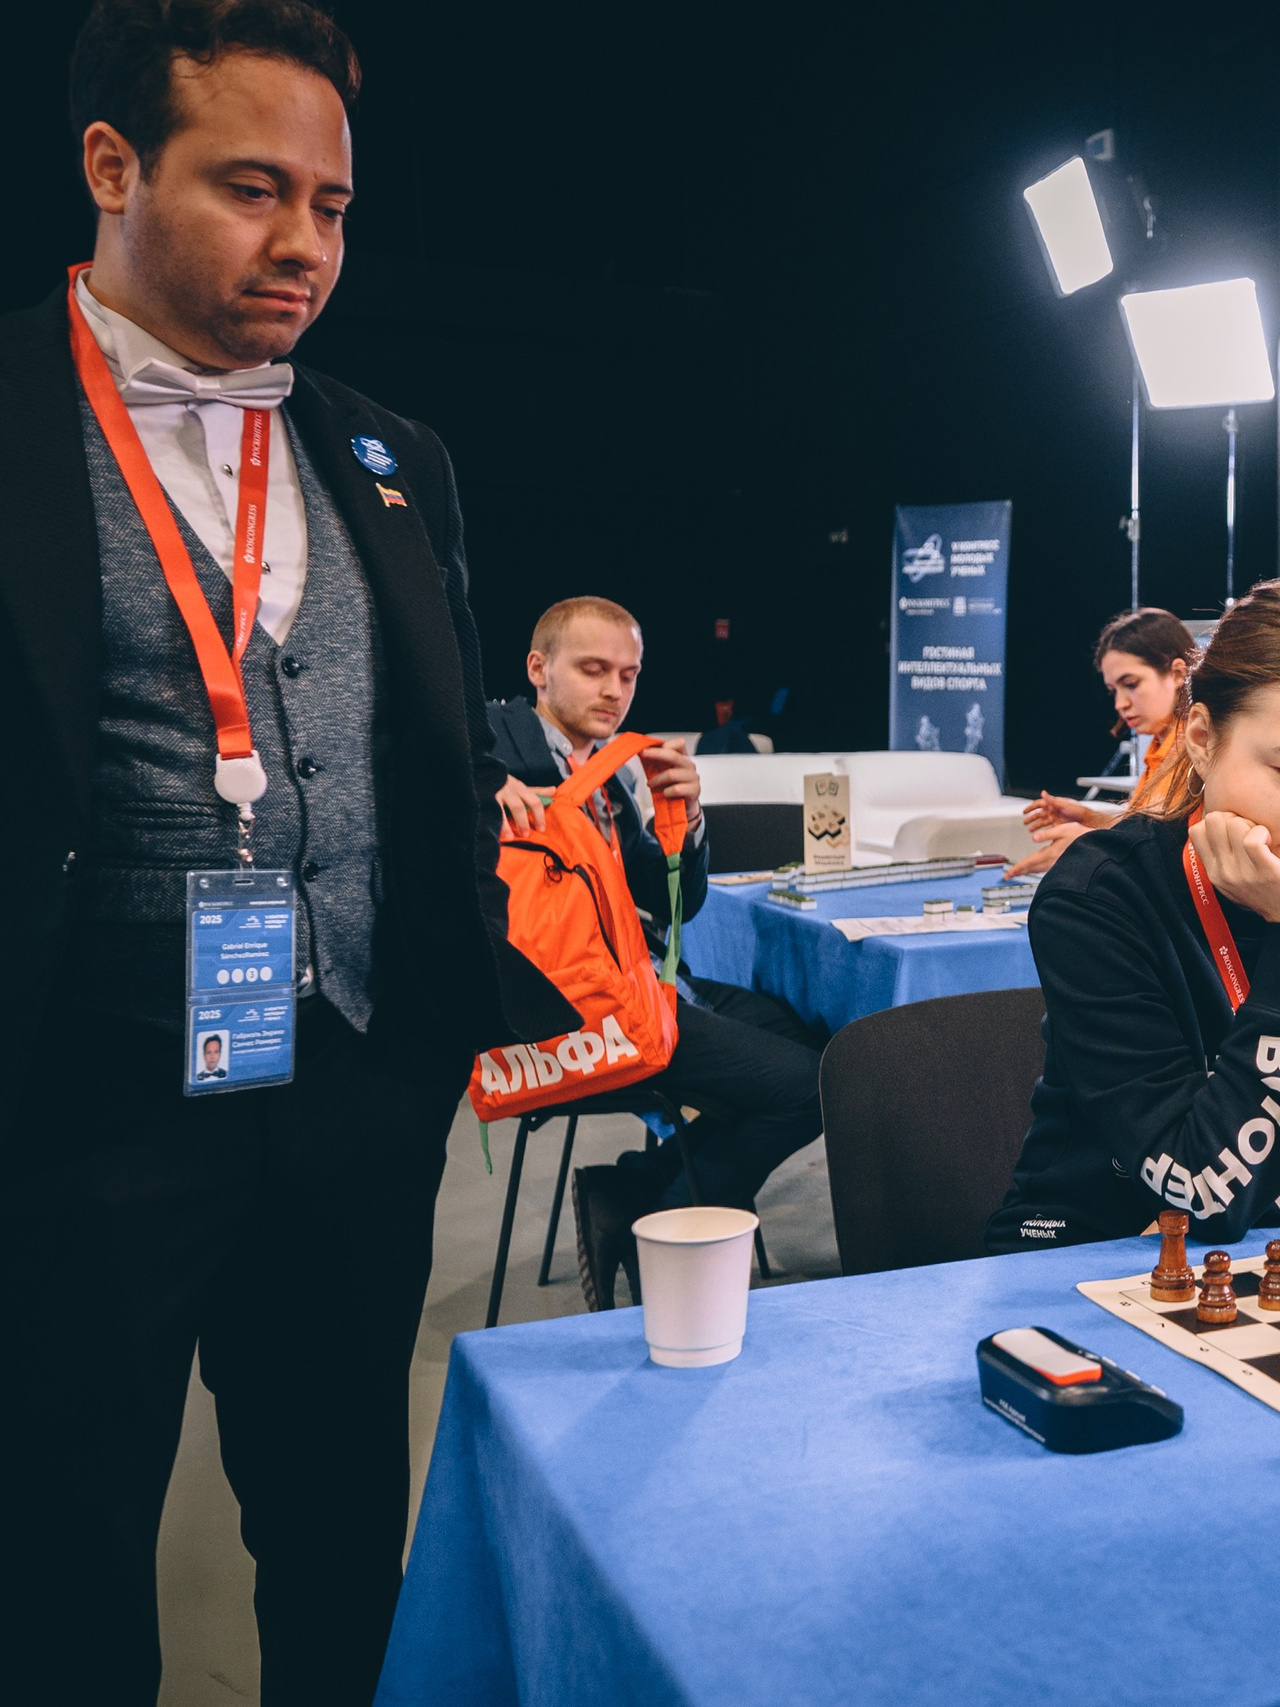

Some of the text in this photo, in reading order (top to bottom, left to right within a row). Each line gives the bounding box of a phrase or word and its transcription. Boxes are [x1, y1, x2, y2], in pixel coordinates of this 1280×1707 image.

[246, 504, 258, 557] ROSCONGRESS
[1188, 850, 1210, 906] РОСКОНГРЕСС
[199, 914, 222, 925] 2025
[198, 1009, 221, 1020] 2025
[479, 1014, 639, 1096] АЛЬФА
[1020, 1228, 1057, 1239] УЧЕНЫХ
